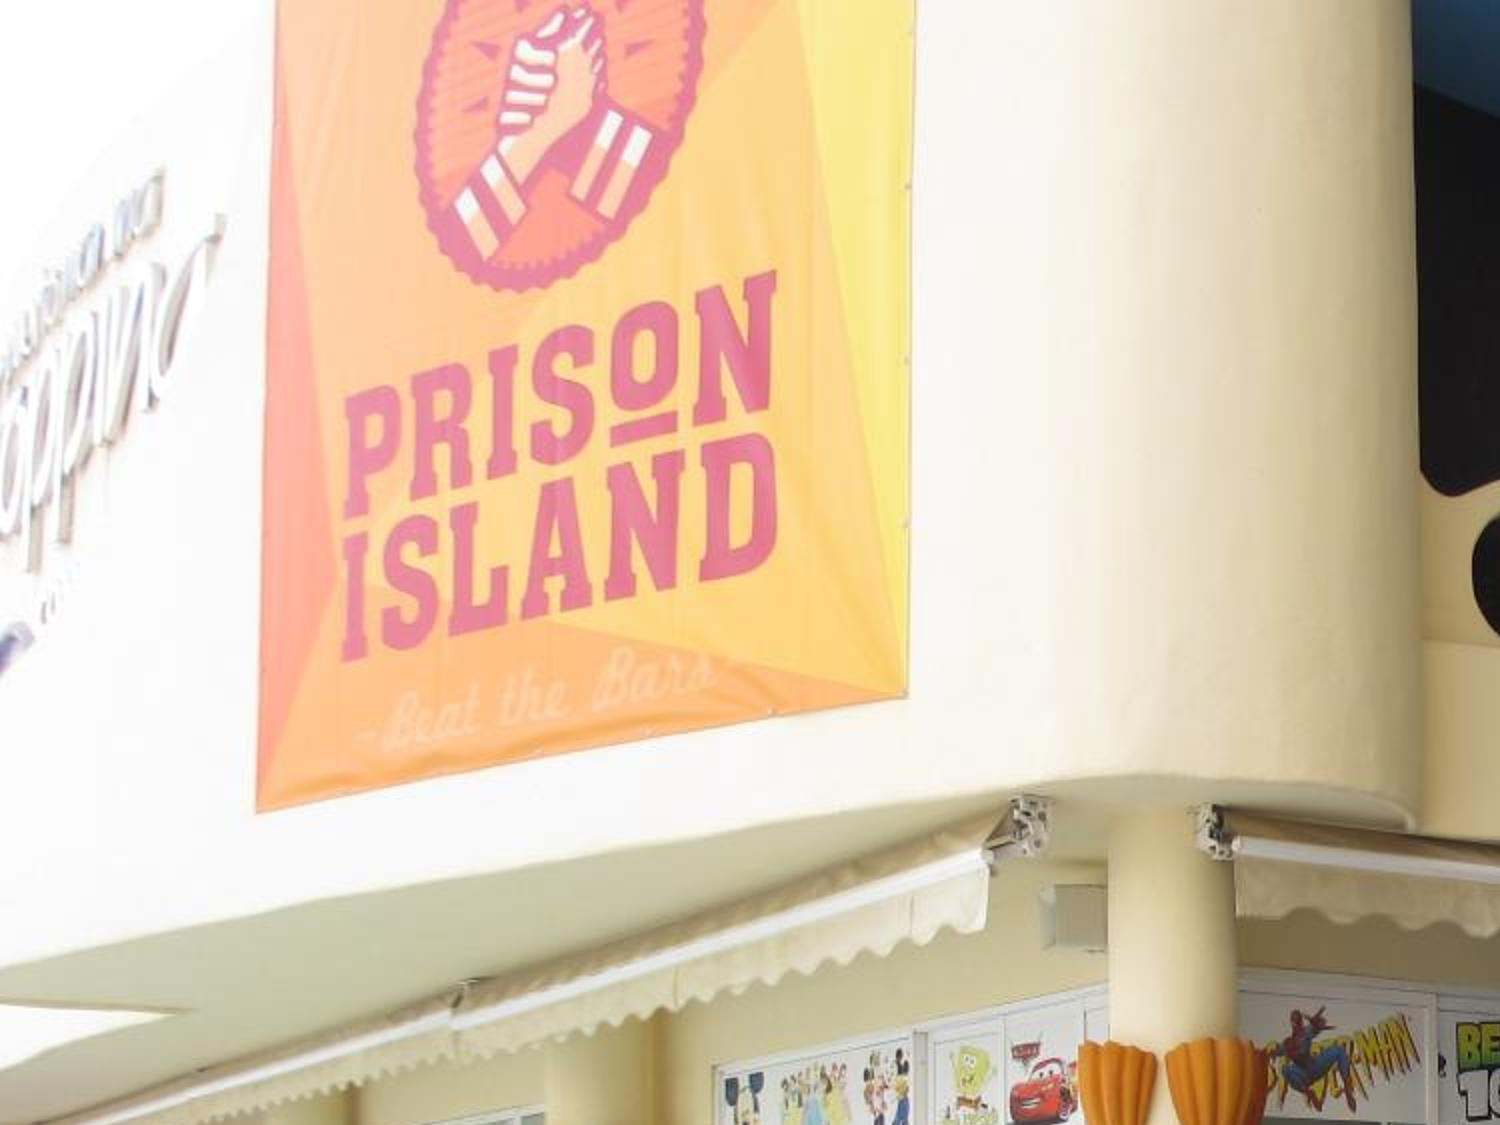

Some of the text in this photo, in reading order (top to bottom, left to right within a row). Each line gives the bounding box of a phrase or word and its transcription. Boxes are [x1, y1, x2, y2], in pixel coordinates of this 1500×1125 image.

[342, 268, 778, 521] PRISON
[340, 431, 778, 663] ISLAND
[1262, 1013, 1422, 1105] SDER-MAN
